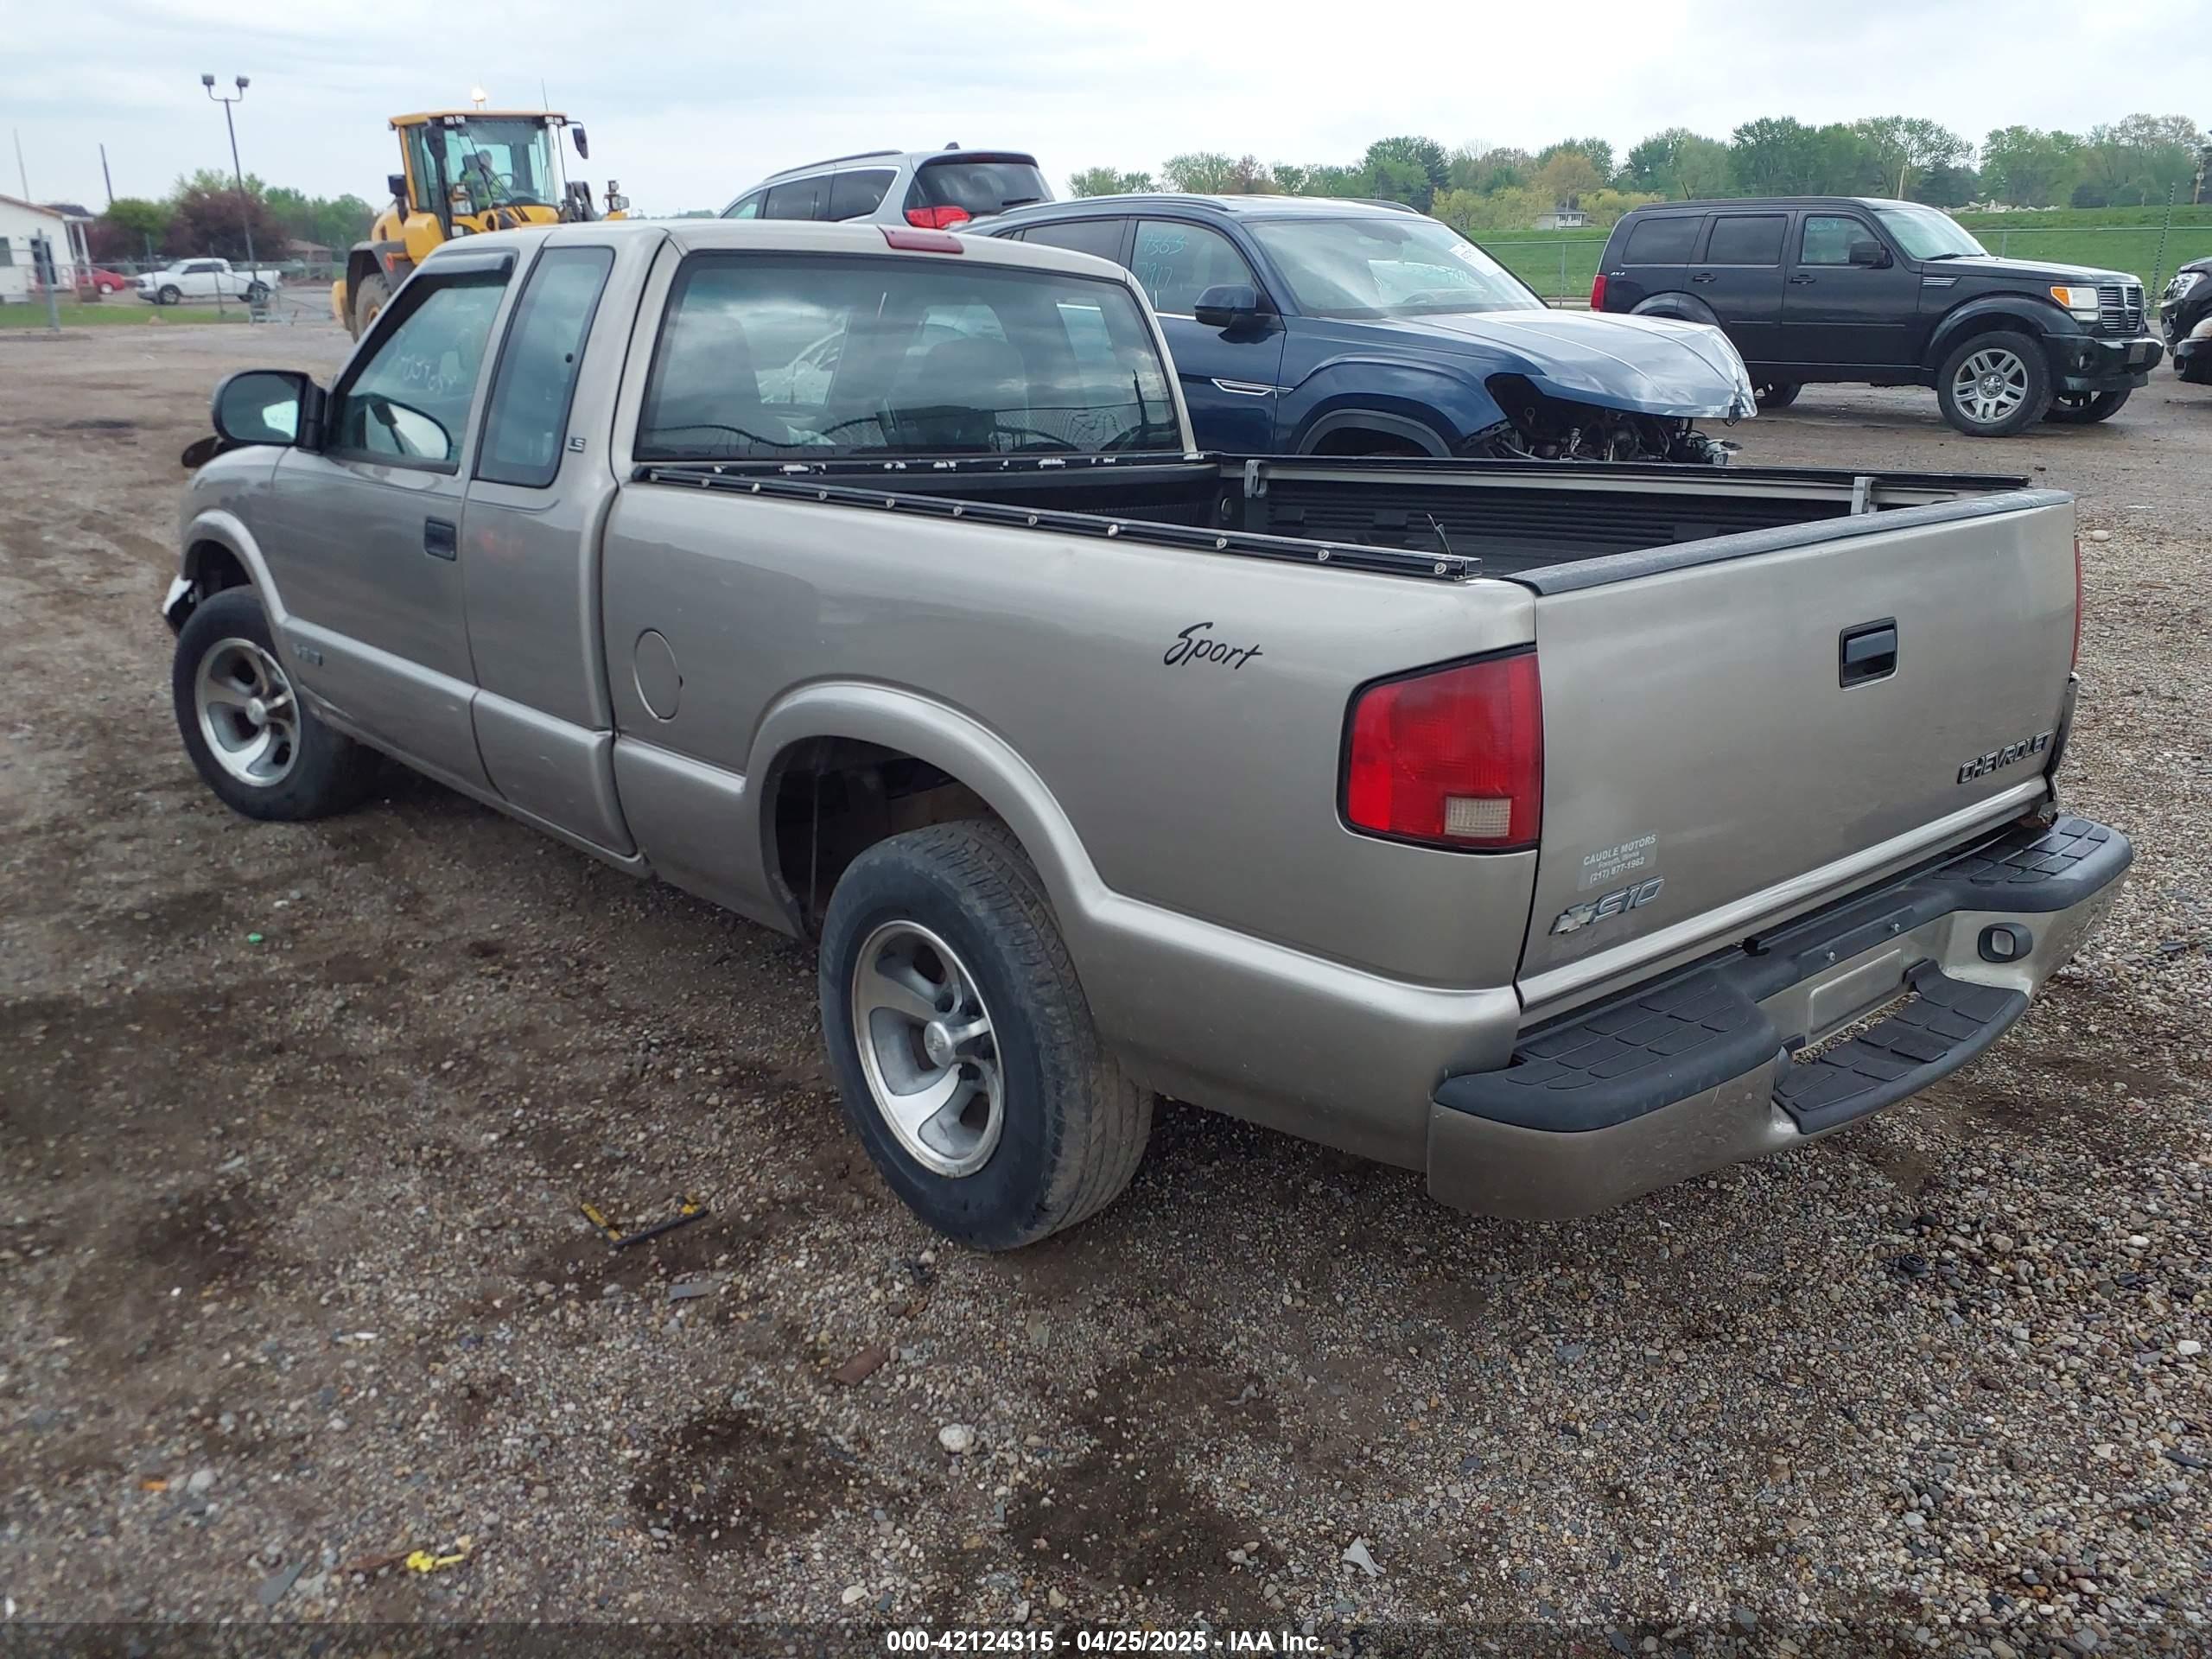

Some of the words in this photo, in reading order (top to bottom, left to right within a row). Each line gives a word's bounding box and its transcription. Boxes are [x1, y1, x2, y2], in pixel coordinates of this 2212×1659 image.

[1164, 621, 1263, 670] Sport
[1957, 728, 2054, 785] CHEVROLET
[1583, 847, 1618, 866] CAUDLE
[1620, 834, 1656, 853] MOTORS
[1590, 869, 1610, 884] (217)
[1592, 875, 1665, 924] S10
